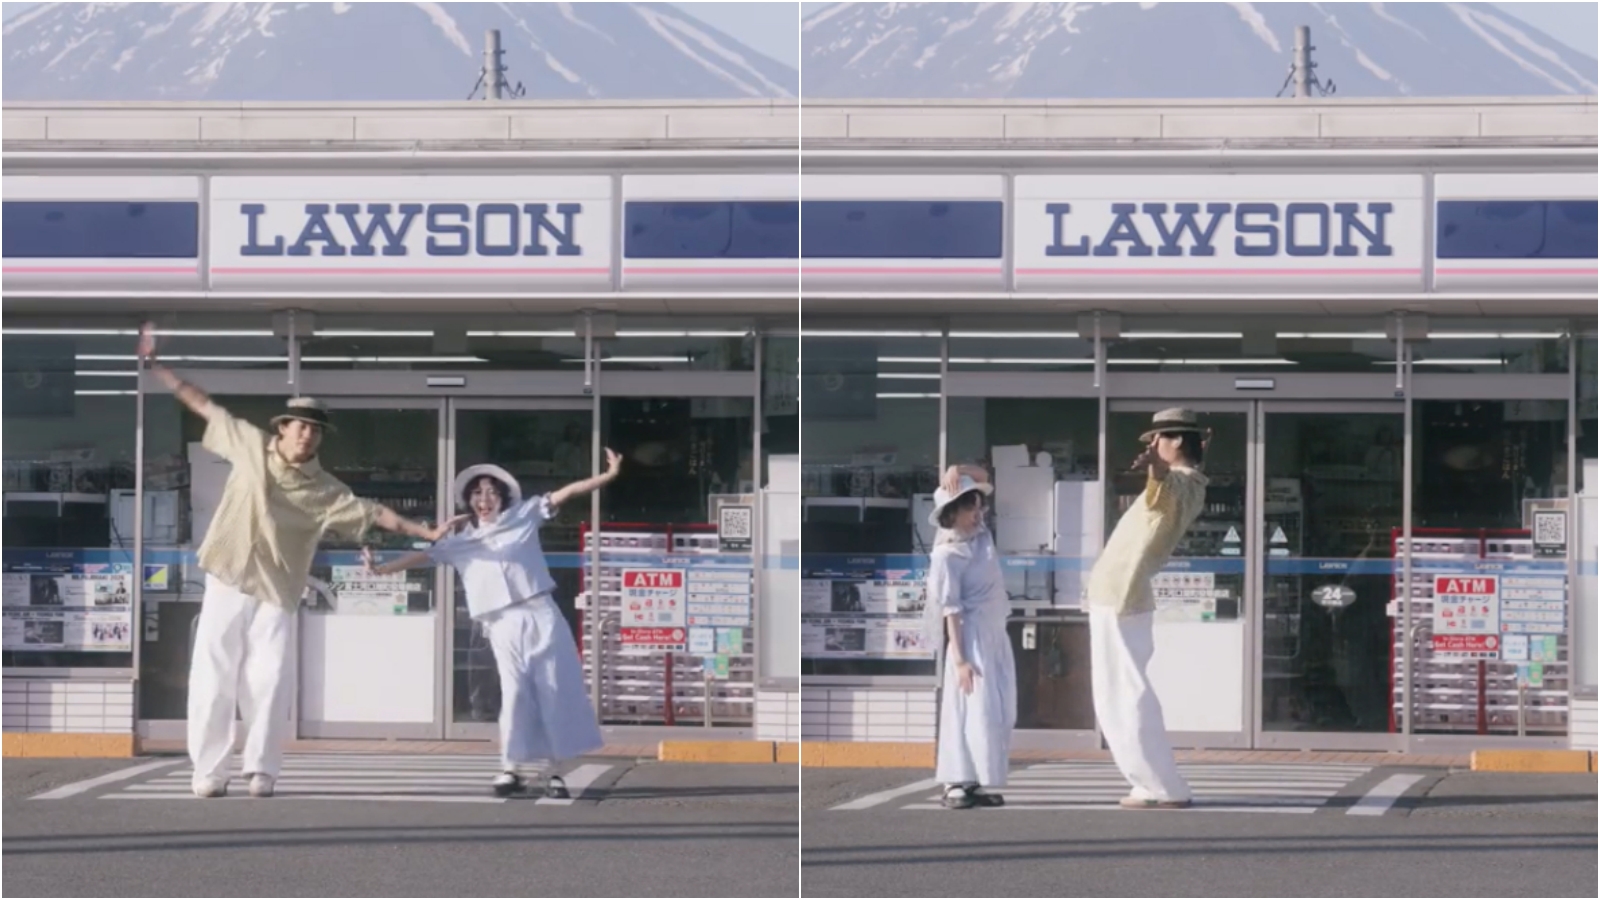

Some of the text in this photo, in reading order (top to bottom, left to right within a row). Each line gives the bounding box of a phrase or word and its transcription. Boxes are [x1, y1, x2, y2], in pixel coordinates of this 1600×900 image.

[240, 203, 582, 256] LAWSON
[1045, 202, 1393, 256] LAWSON
[634, 573, 673, 586] ATM
[1446, 579, 1487, 593] ATM
[1322, 587, 1342, 600] 24
